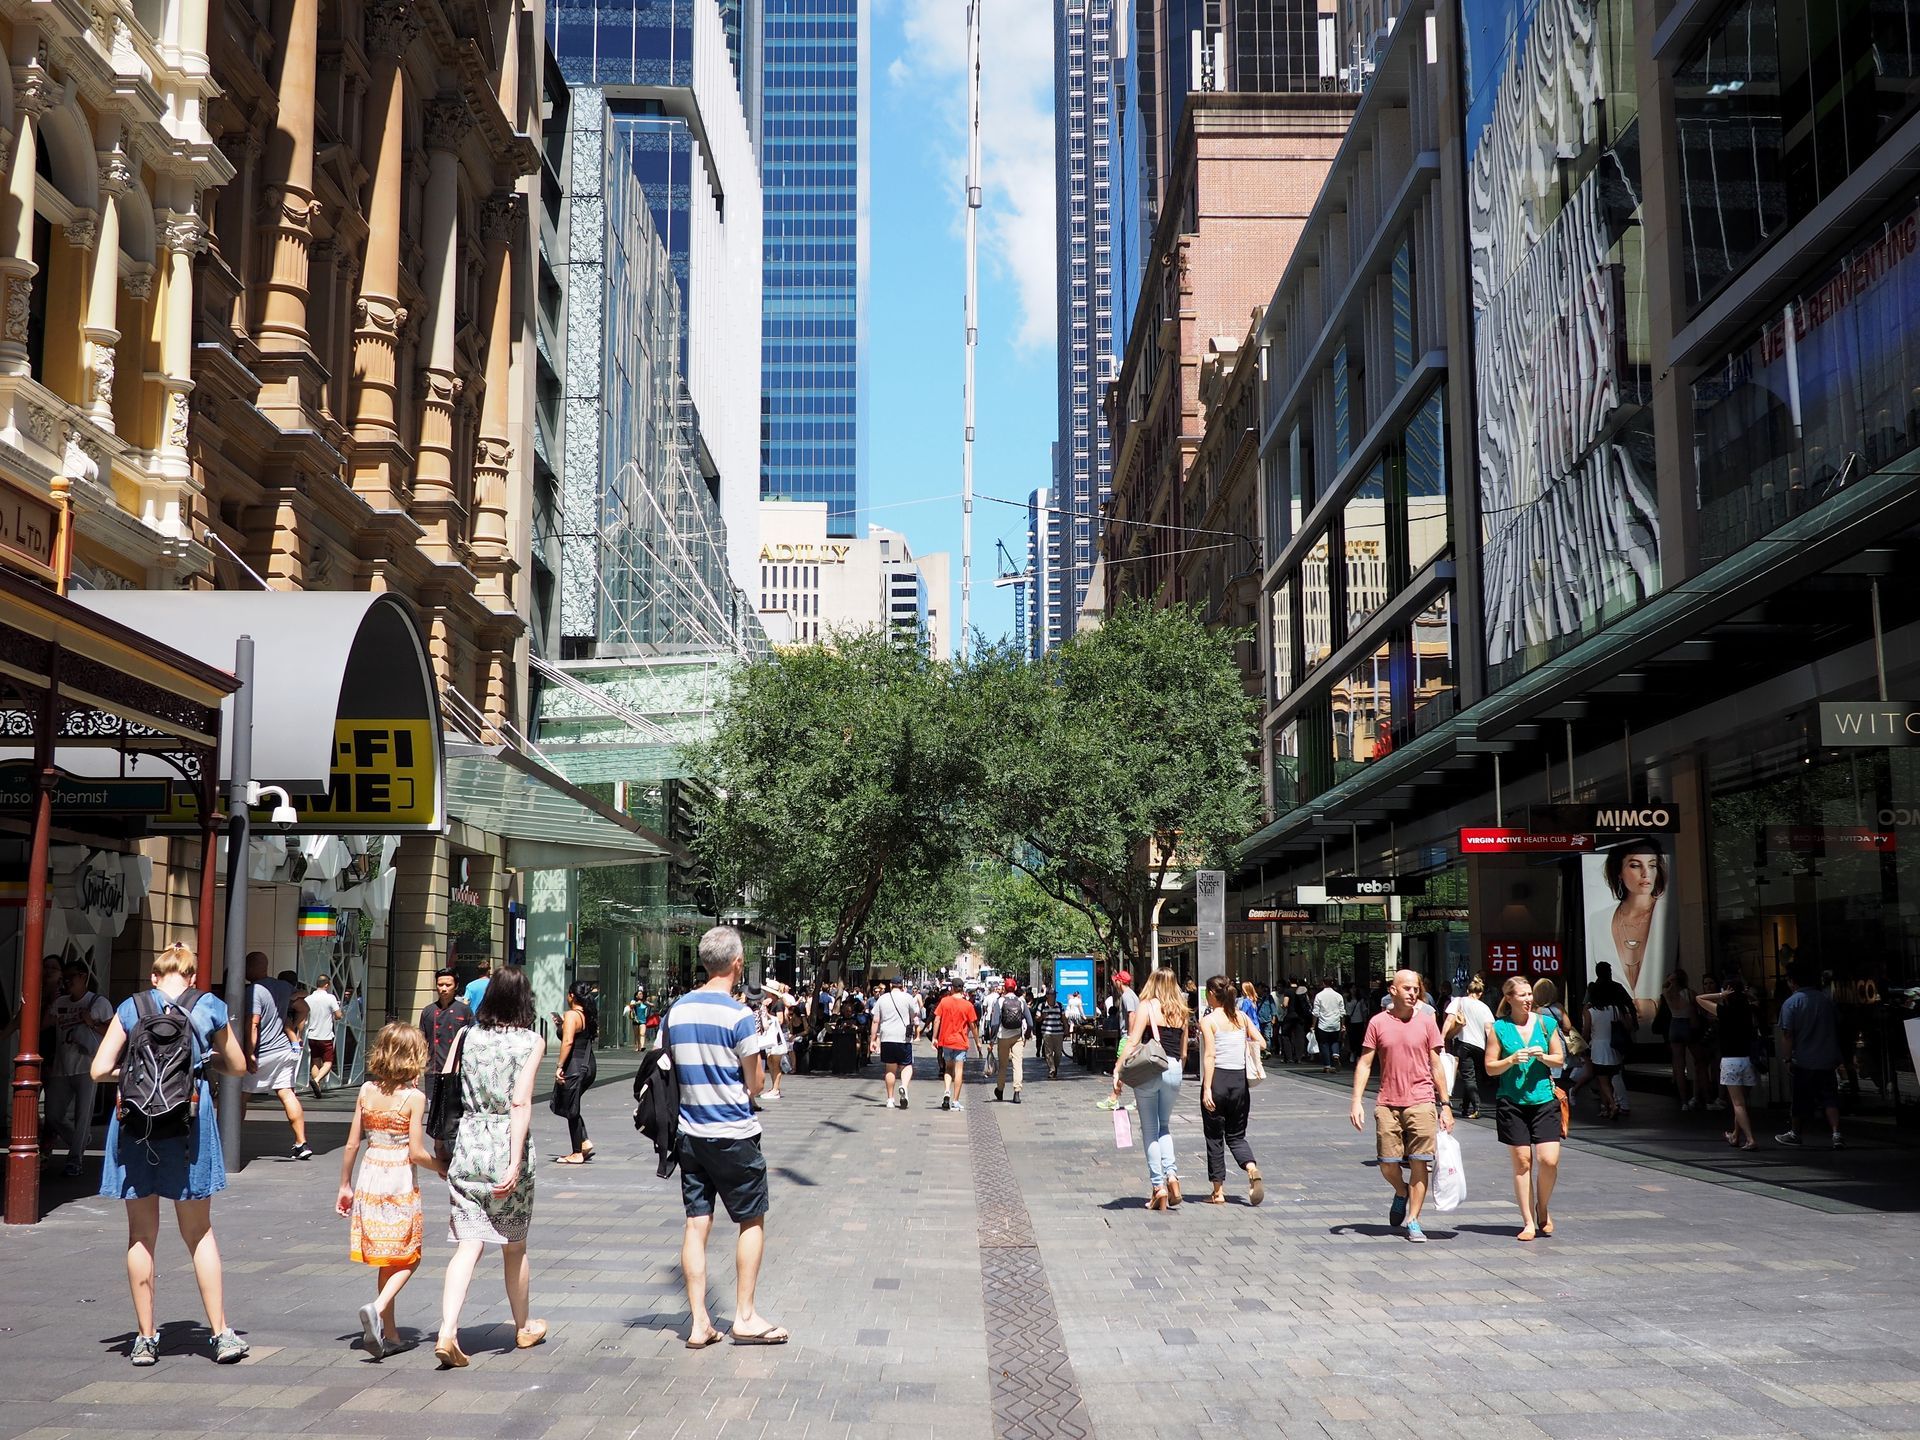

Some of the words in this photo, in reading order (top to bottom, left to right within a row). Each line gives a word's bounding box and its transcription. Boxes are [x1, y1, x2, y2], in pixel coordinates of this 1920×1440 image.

[1808, 215, 1918, 332] REINVENTING
[1595, 809, 1670, 832] MIMCO
[1198, 878, 1220, 887] Street
[1201, 872, 1214, 881] Pitt
[1198, 886, 1216, 894] Mall
[1356, 879, 1396, 894] rebel
[1248, 908, 1277, 918] General
[1278, 908, 1298, 918] Pants
[1298, 908, 1309, 918] Co.
[1532, 945, 1557, 958] UNI
[1532, 959, 1559, 973] QLO
